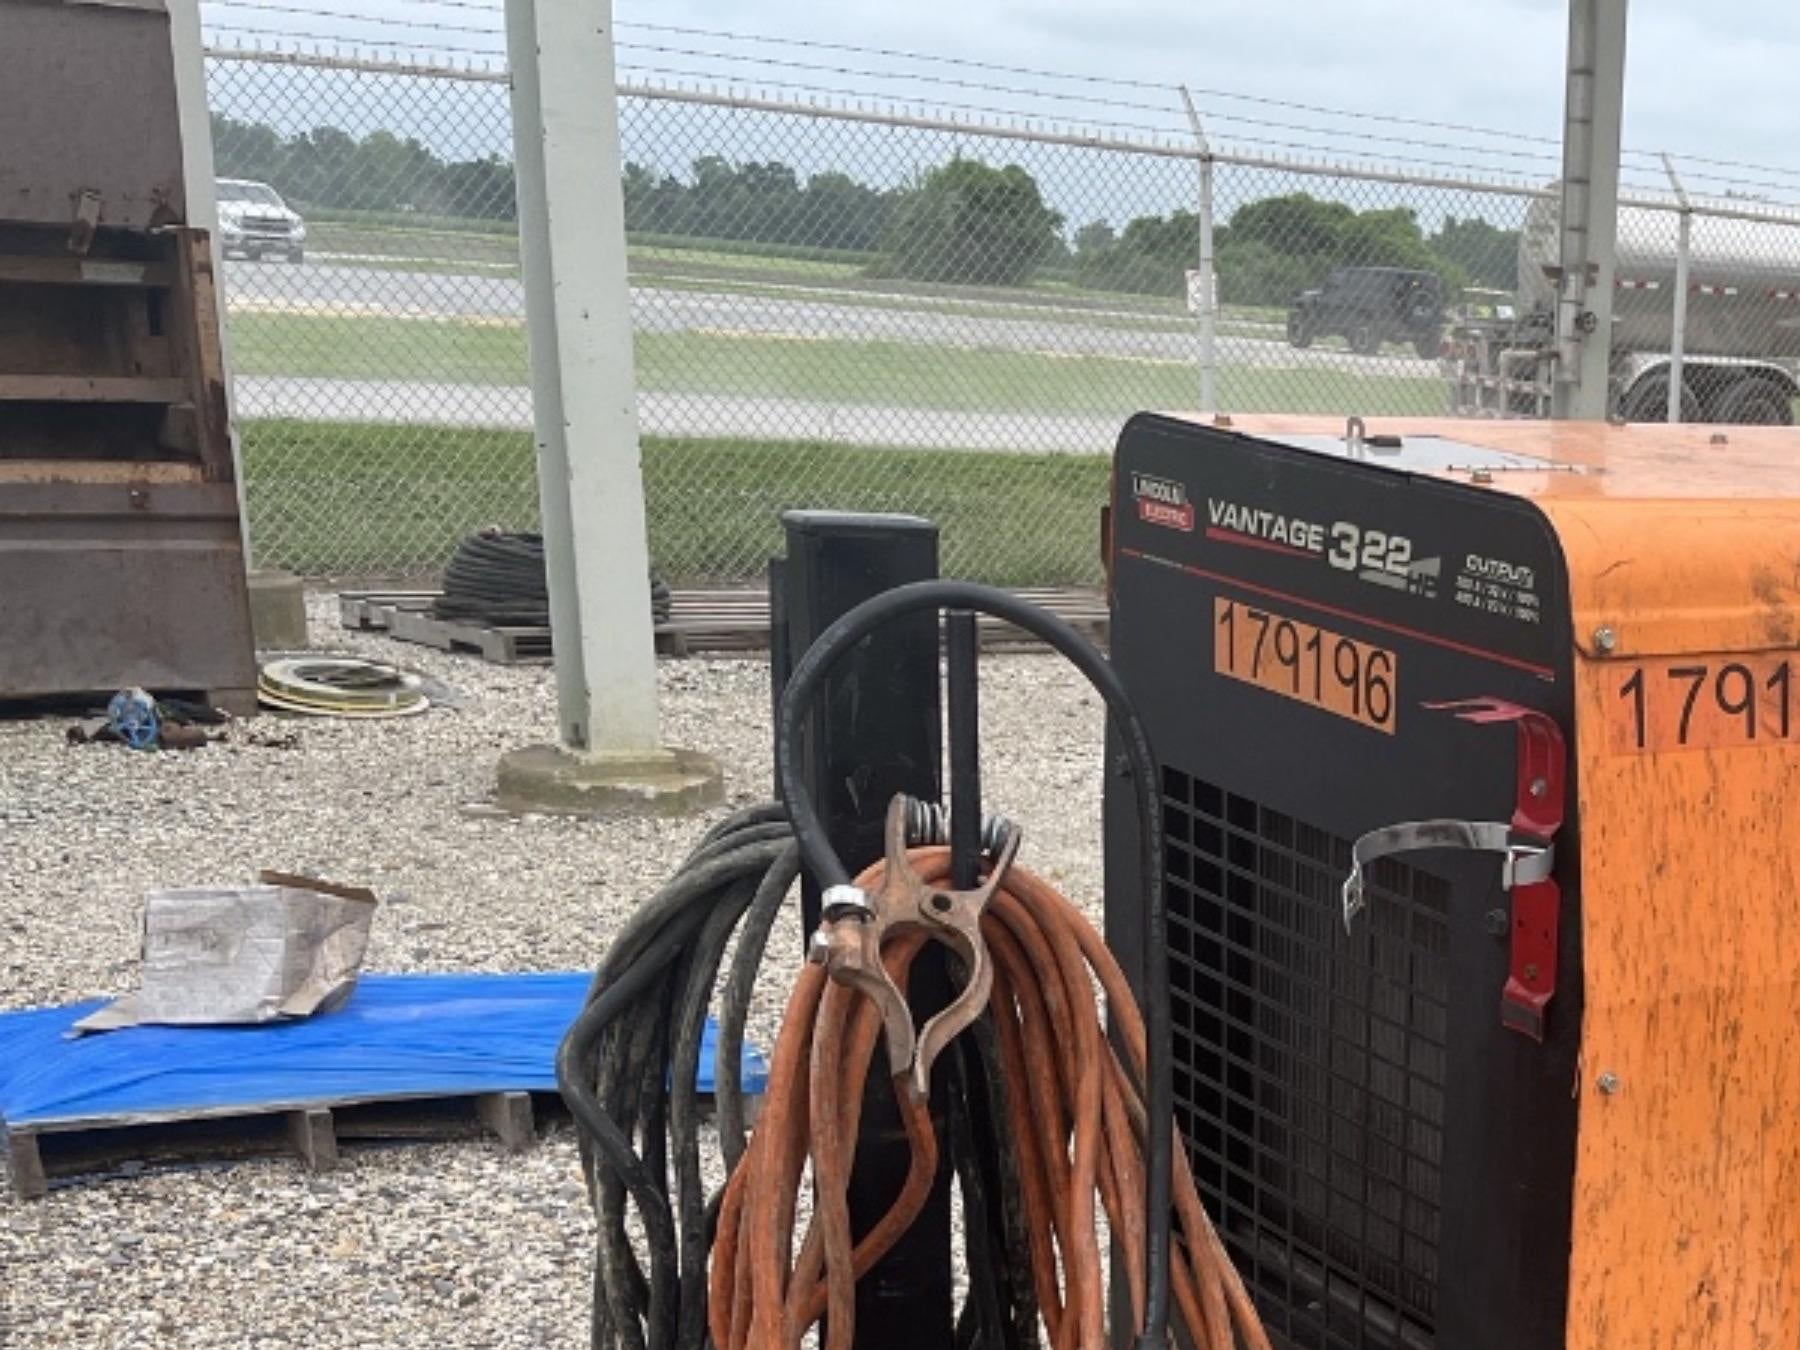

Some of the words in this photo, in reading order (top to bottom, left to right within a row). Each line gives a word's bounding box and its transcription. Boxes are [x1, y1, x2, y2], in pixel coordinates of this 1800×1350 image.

[1207, 497, 1325, 553] VANTAGE
[1328, 520, 1411, 578] 322
[1219, 601, 1393, 724] 179196
